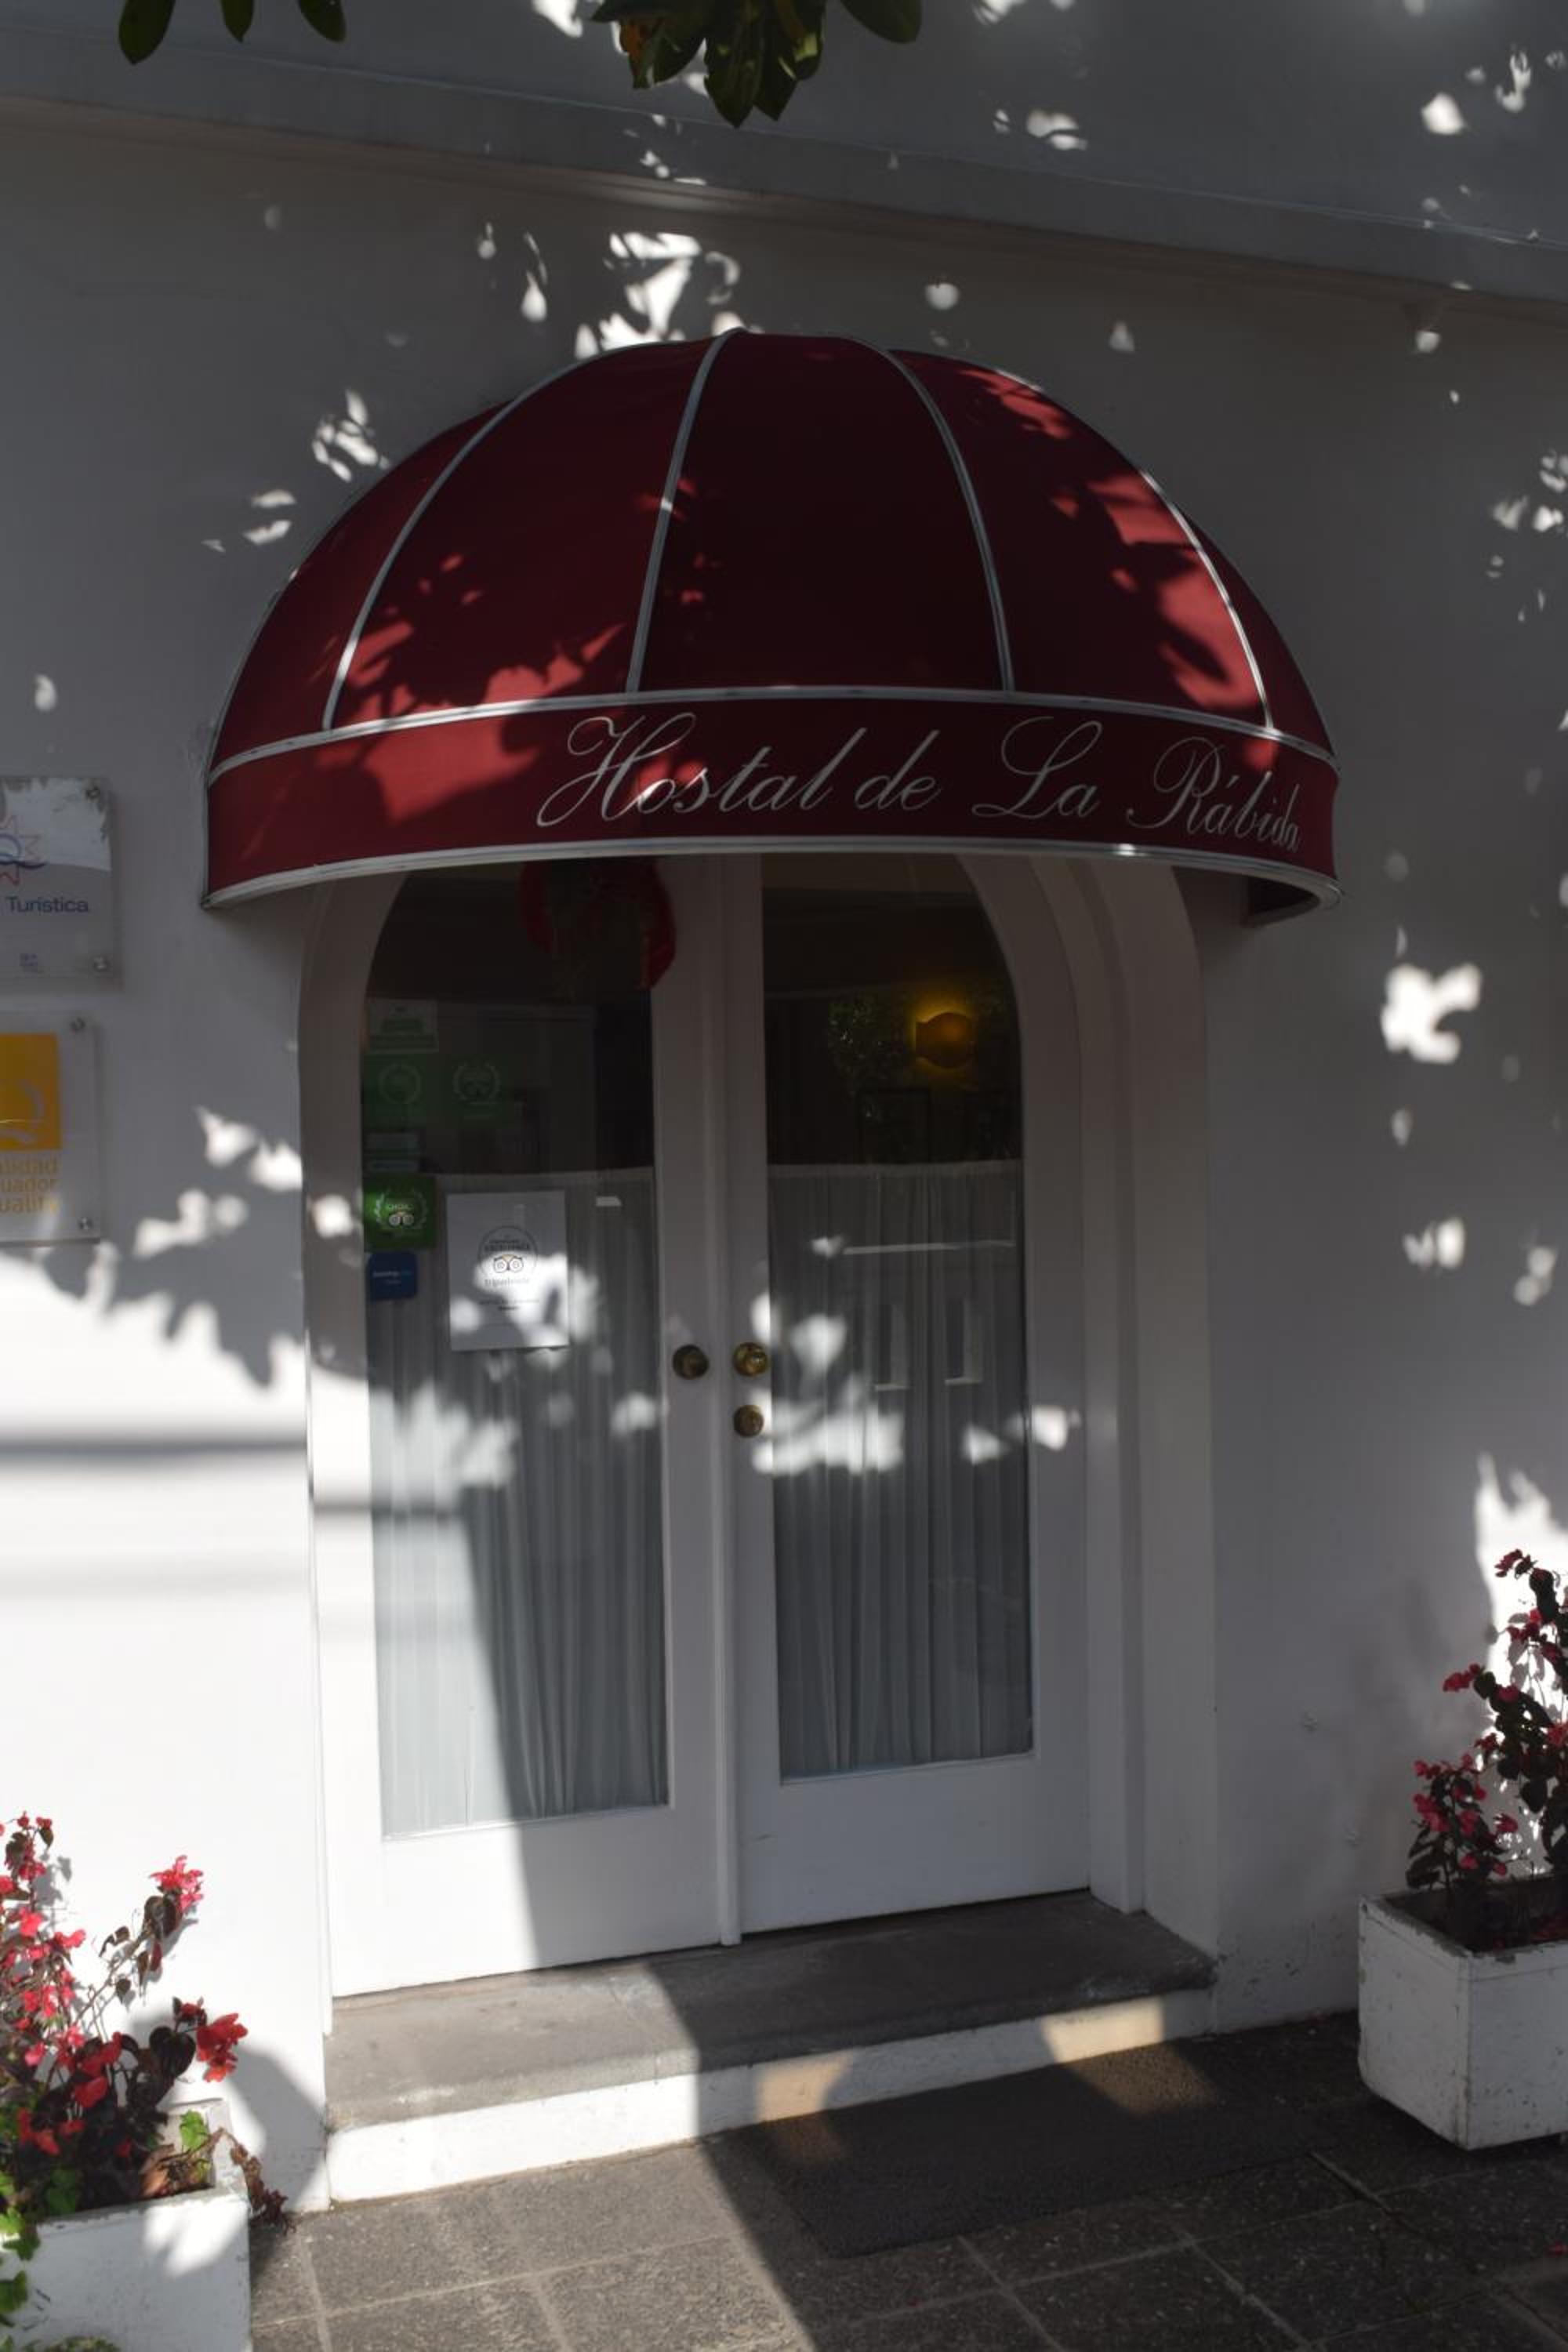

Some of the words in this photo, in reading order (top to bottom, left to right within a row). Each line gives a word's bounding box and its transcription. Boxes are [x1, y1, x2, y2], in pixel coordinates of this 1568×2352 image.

[536, 711, 868, 828] Hostal
[853, 728, 942, 812] de
[971, 715, 1102, 821] La
[1125, 735, 1301, 853] Rábida
